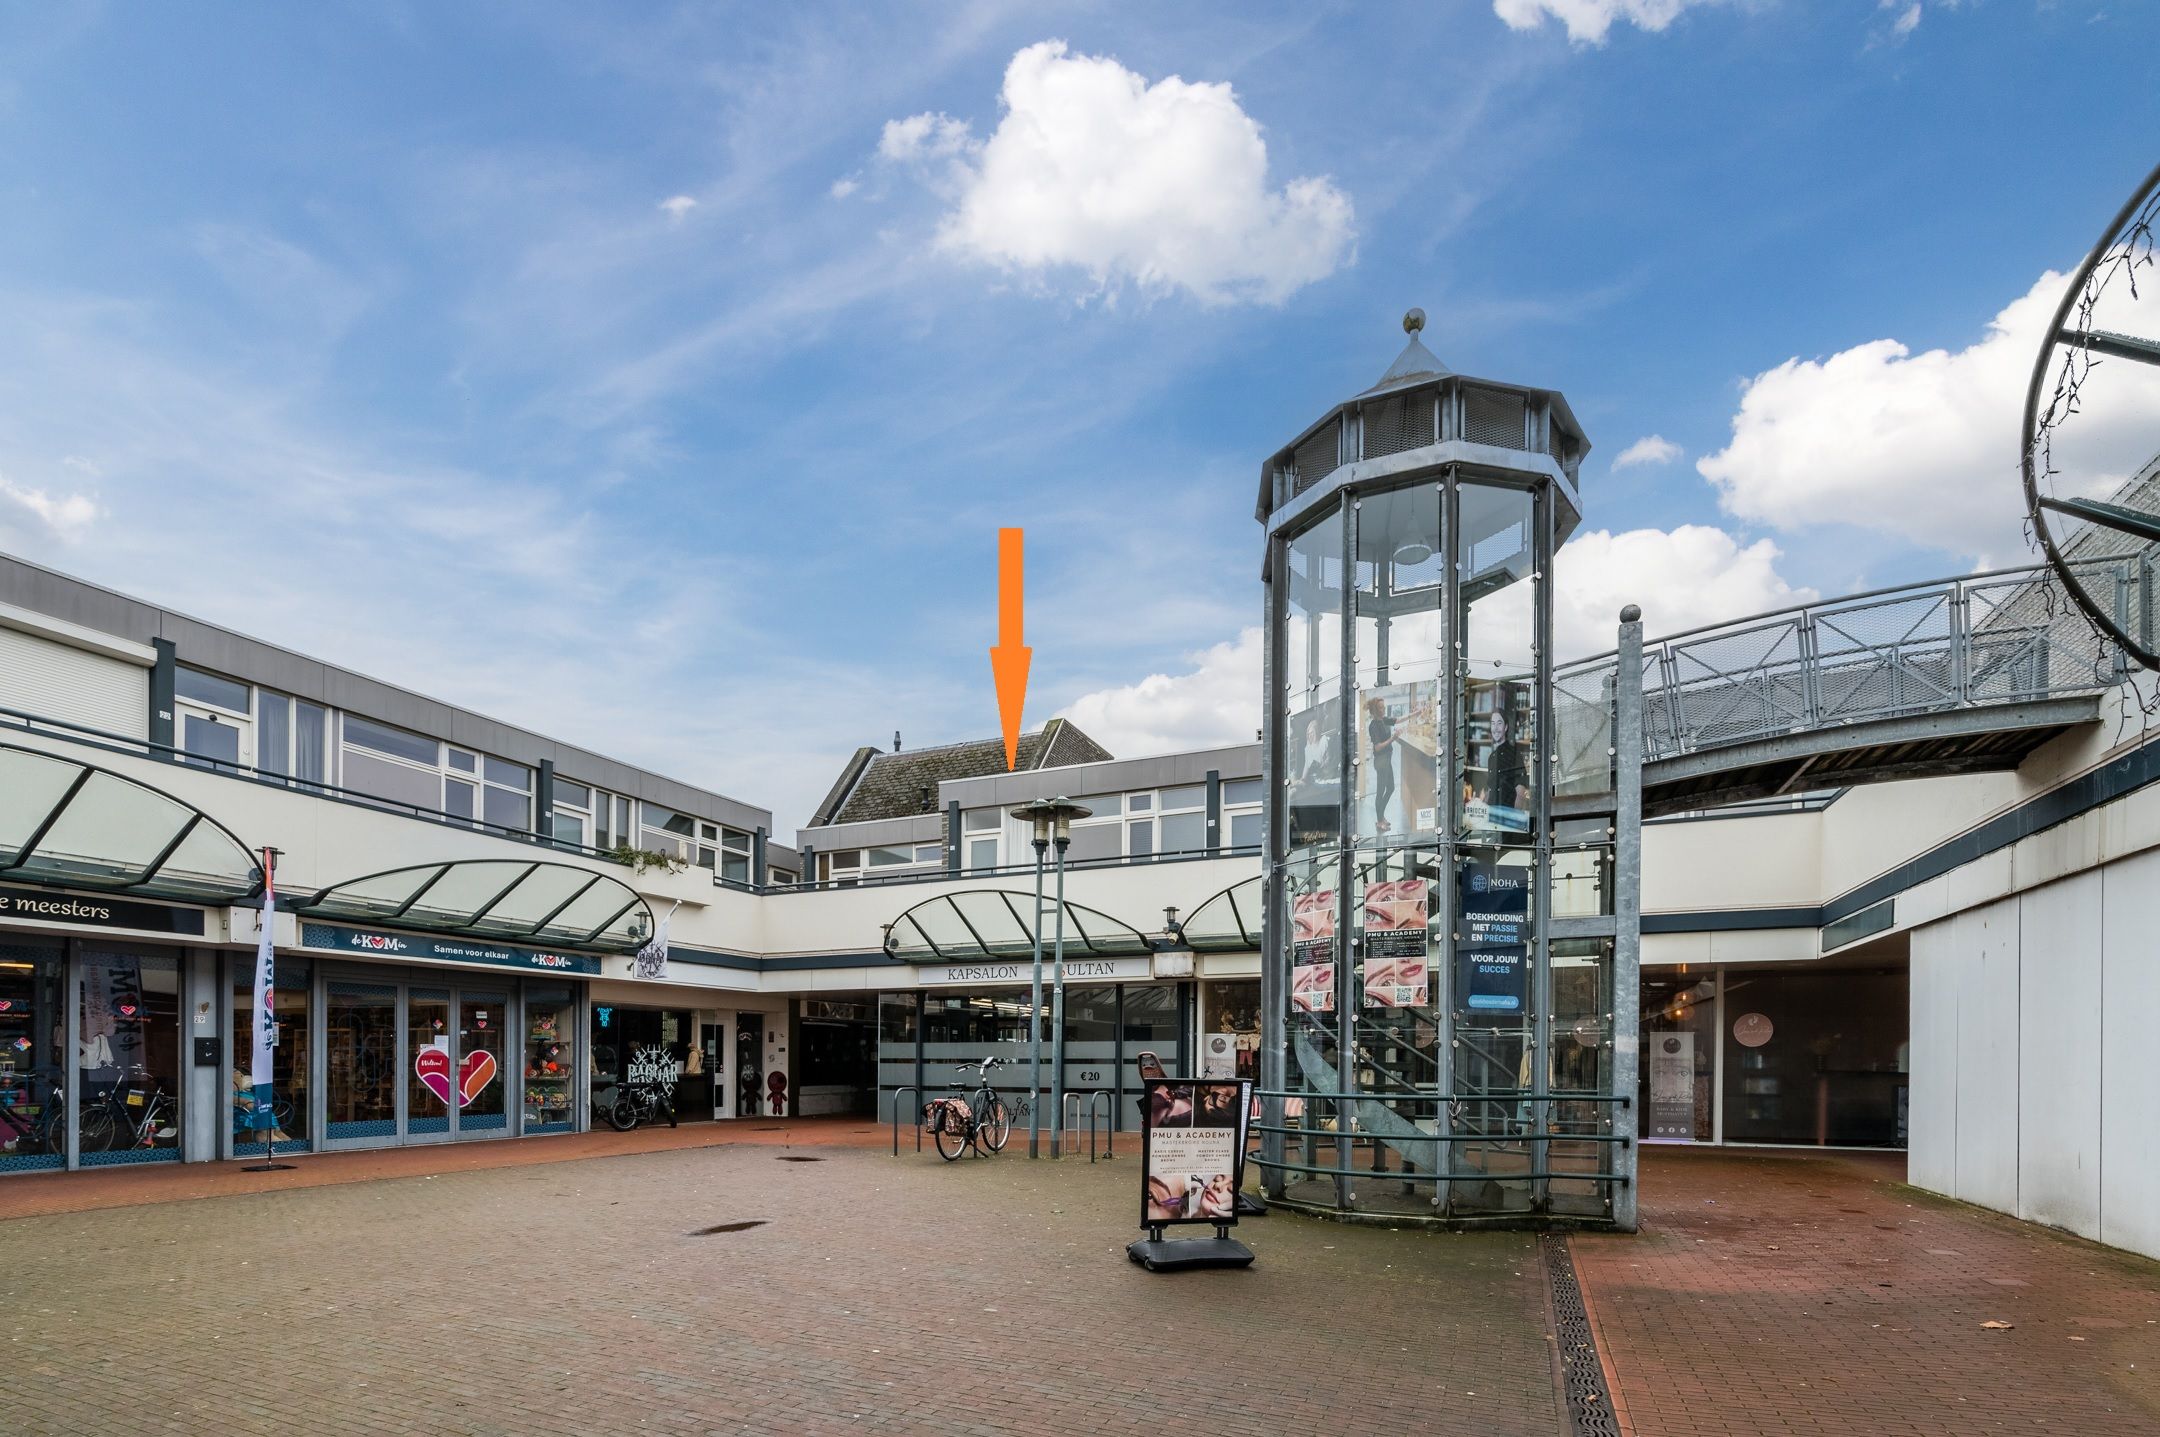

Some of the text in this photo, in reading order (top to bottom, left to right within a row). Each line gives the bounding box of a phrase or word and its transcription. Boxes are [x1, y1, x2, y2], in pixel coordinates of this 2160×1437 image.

[1490, 879, 1518, 888] NOHA
[15, 898, 110, 919] meesters
[1466, 912, 1524, 922] BOEKHOUDING
[1472, 923, 1518, 932] MET PASSIE
[1484, 934, 1518, 943] PRECISIE
[434, 945, 463, 955] Samen
[485, 951, 509, 960] elkaar
[1471, 954, 1518, 963] VOOR JOUW
[948, 962, 1115, 980] KAPSALON ULTAN
[1479, 965, 1510, 974] SUCCES
